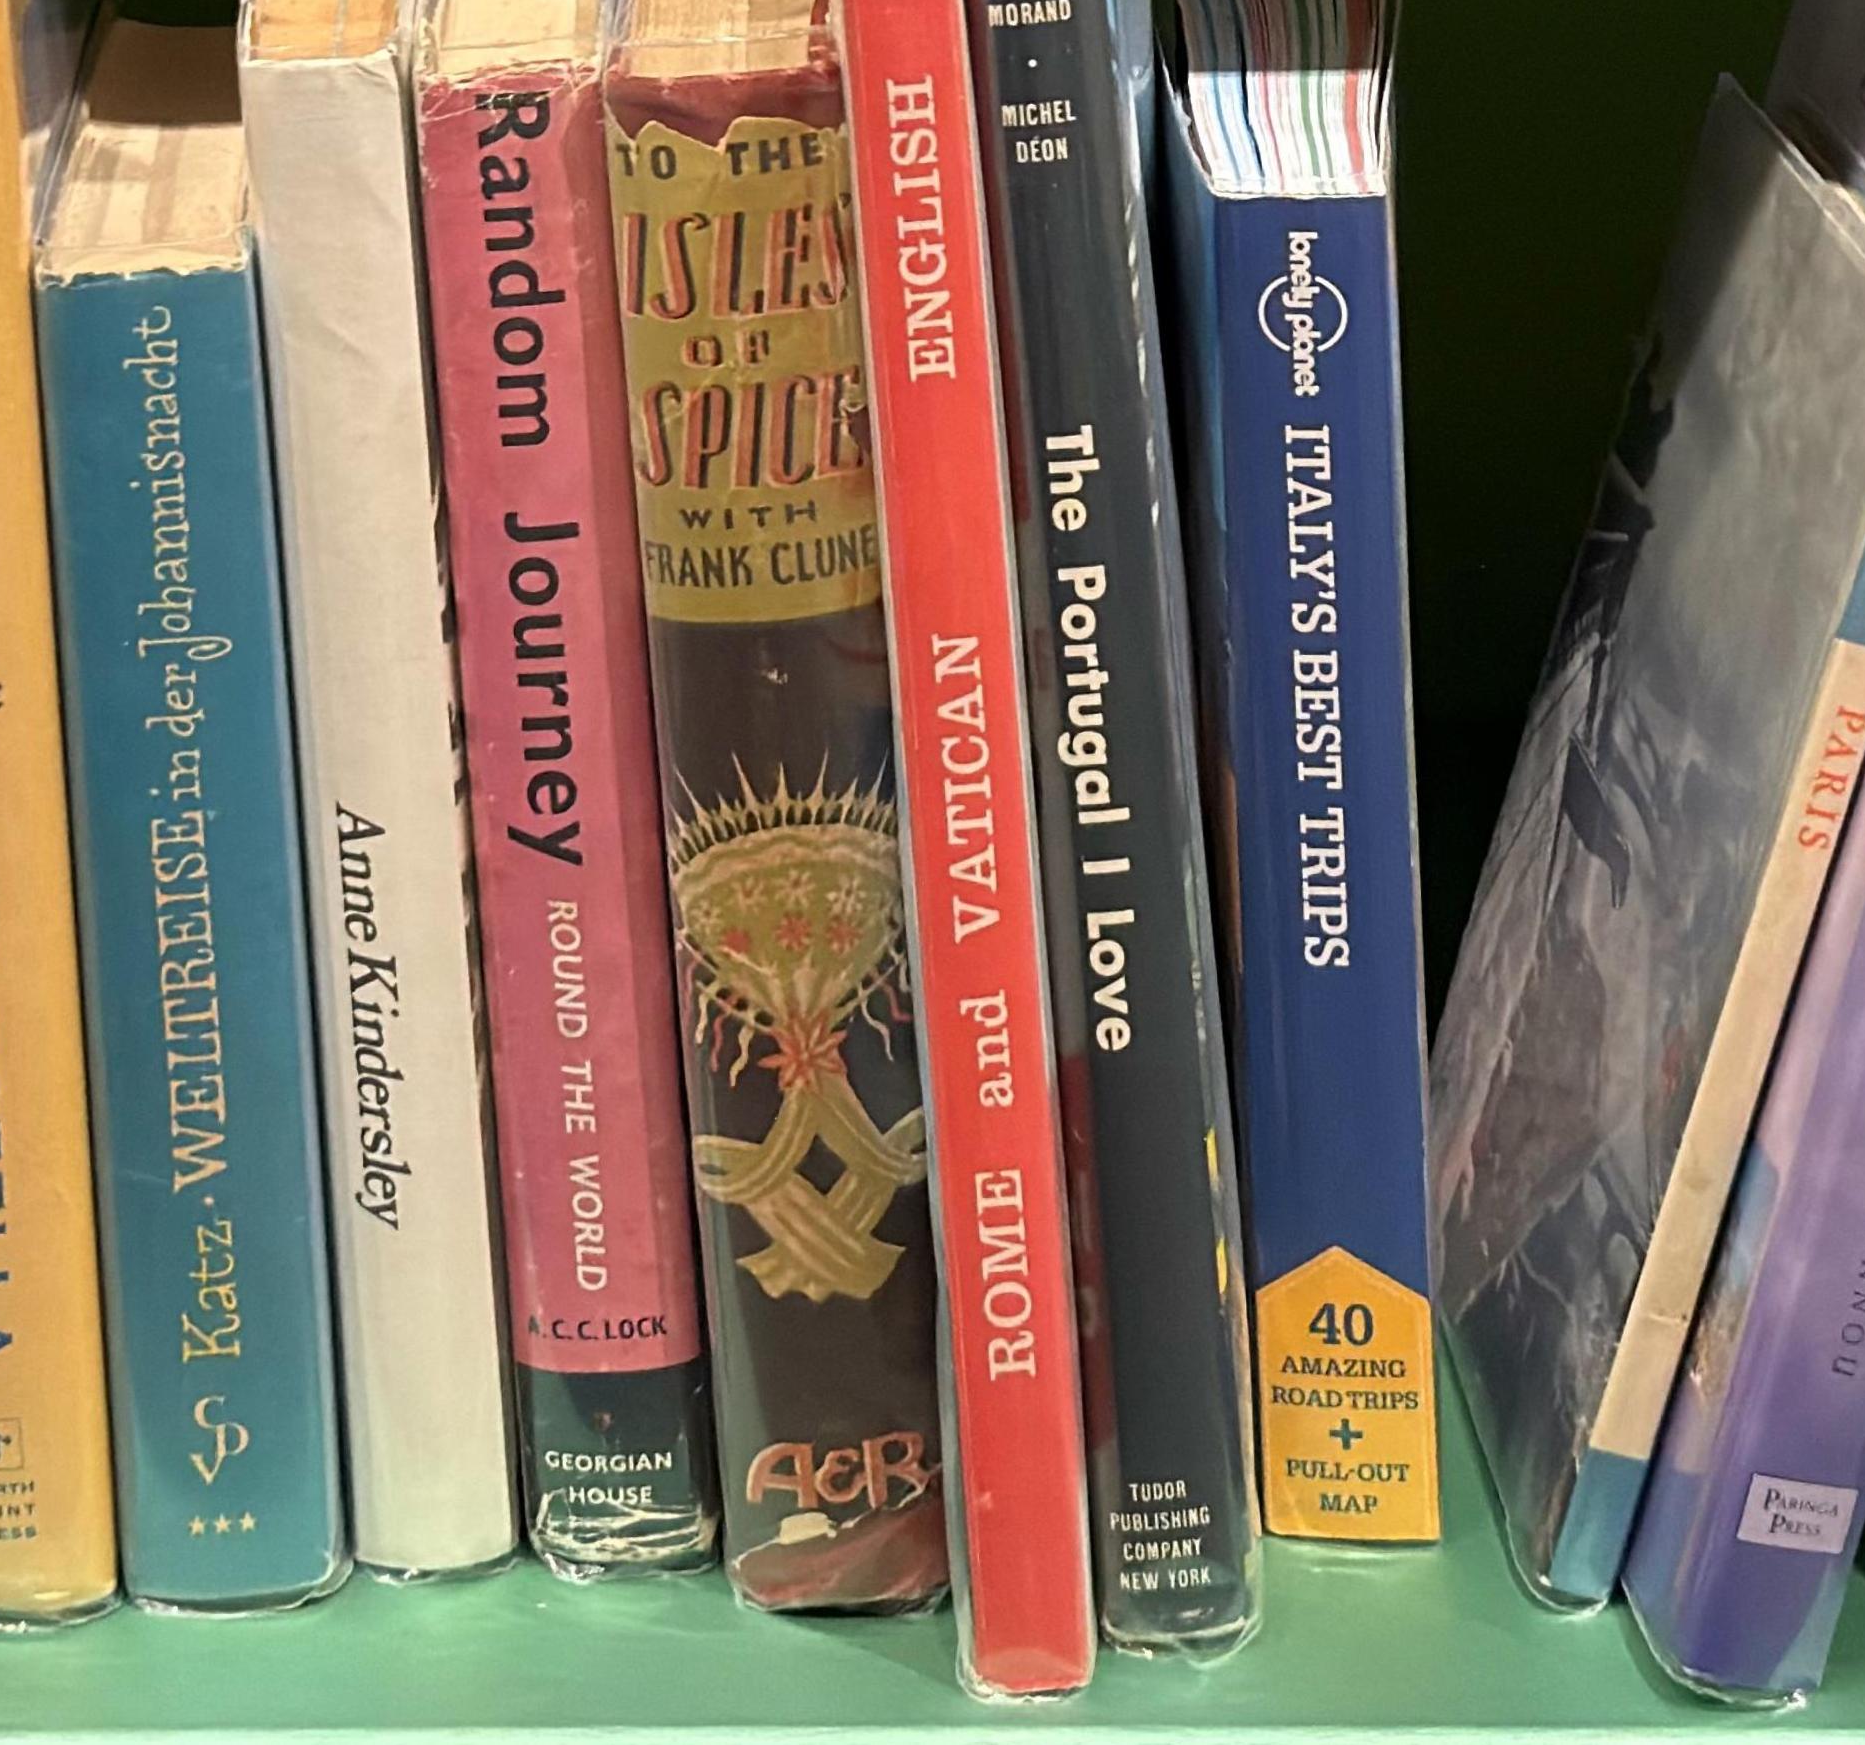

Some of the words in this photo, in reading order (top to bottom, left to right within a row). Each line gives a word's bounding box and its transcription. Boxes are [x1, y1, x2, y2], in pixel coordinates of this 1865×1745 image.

[987, 0, 1072, 28] MORAND
[1001, 99, 1077, 127] MICHEL
[1015, 134, 1069, 165] DÉON
[615, 142, 677, 180] TO
[724, 131, 825, 177] THE
[621, 192, 852, 322] ISLES
[886, 73, 957, 383] ENGLISH
[475, 90, 566, 449] Random
[1281, 230, 1322, 309] lonely
[682, 327, 771, 369] OF
[1283, 314, 1323, 398] planet
[636, 363, 867, 490] SPICE
[122, 303, 233, 660] Johannisnacht
[679, 500, 818, 531] WITH
[1045, 423, 1102, 532] The
[646, 541, 754, 589] FRANK
[770, 522, 878, 587] CLUNE
[1283, 422, 1338, 634] ITALY'S
[146, 662, 206, 740] der
[503, 511, 583, 867] Journey
[1056, 563, 1131, 826] Portugal
[1291, 649, 1344, 791] BEST
[149, 749, 203, 800] in
[931, 632, 999, 946] VATICAN
[336, 801, 387, 941] Anne
[1081, 855, 1131, 878] I
[1298, 804, 1351, 970] TRIPS
[149, 808, 229, 1194] WELTREISE
[545, 899, 590, 1041] ROUND
[1086, 907, 1136, 1053] Love
[959, 988, 1015, 1111] and
[346, 947, 413, 1232] Kindersley
[559, 1060, 597, 1135] THE
[567, 1158, 608, 1293] WORLD
[181, 1219, 244, 1364] Katz
[973, 1166, 1037, 1383] ROME
[604, 1315, 668, 1341] LOCK
[1309, 1303, 1374, 1346] 40
[1271, 1385, 1343, 1409] ROAD
[1346, 1390, 1419, 1411] TRIPS
[1281, 1355, 1407, 1379] AMAZING
[543, 1450, 673, 1475] GEORGIAN
[568, 1485, 654, 1505] HOUSE
[1128, 1479, 1187, 1503] TUDOR
[1285, 1458, 1410, 1483] PULL-OUT
[1109, 1505, 1211, 1533] PUBLISHING
[1318, 1493, 1378, 1514] MAP
[1119, 1570, 1160, 1591] NEW
[1168, 1566, 1212, 1590] YORK
[1123, 1537, 1203, 1562] COMPANY
